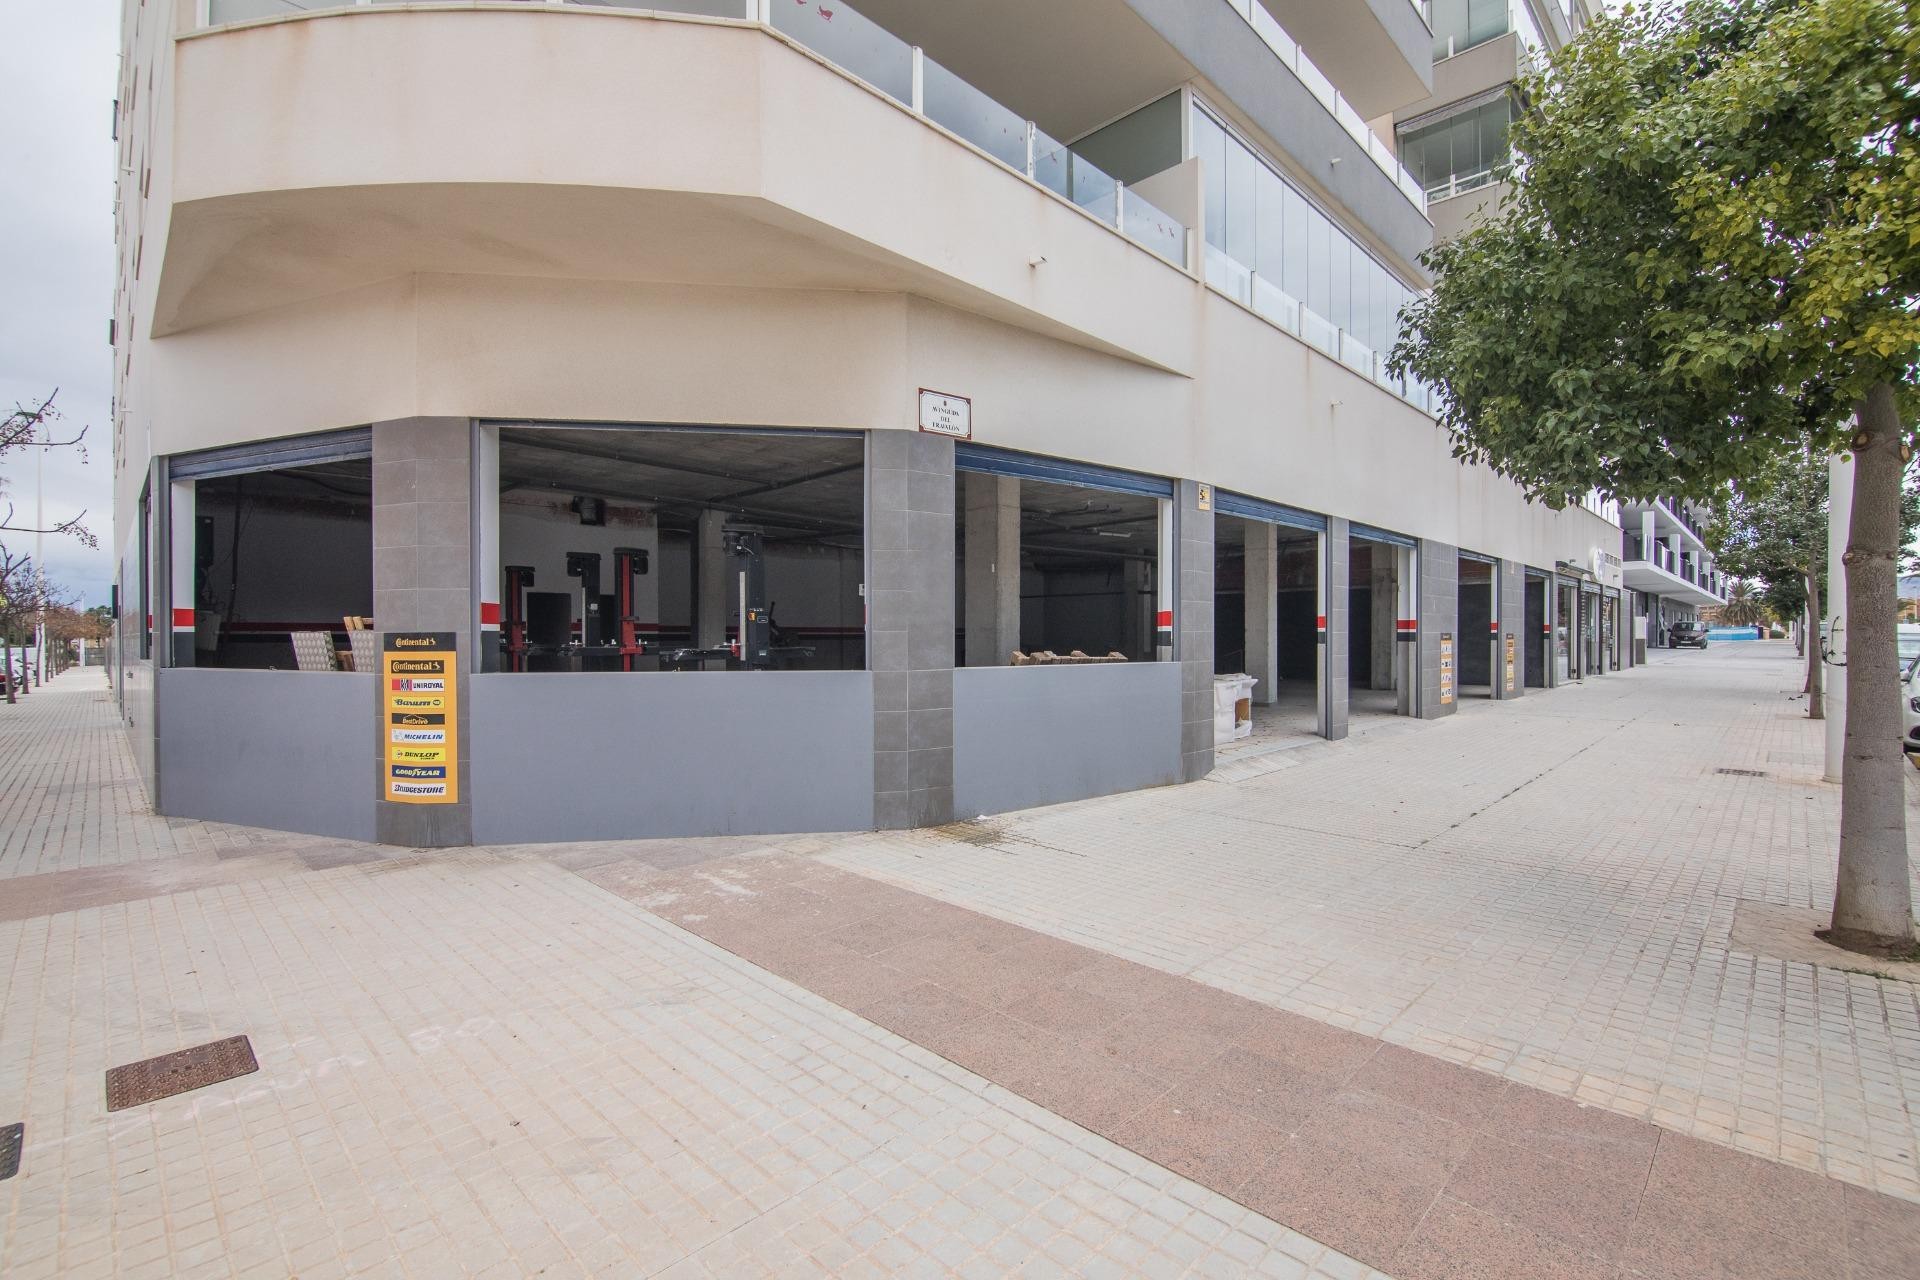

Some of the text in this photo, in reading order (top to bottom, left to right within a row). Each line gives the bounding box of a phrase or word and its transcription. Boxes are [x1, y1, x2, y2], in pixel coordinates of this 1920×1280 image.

[395, 638, 429, 647] Continental
[392, 661, 432, 672] Continental
[394, 784, 444, 793] BRIDGESTONE
